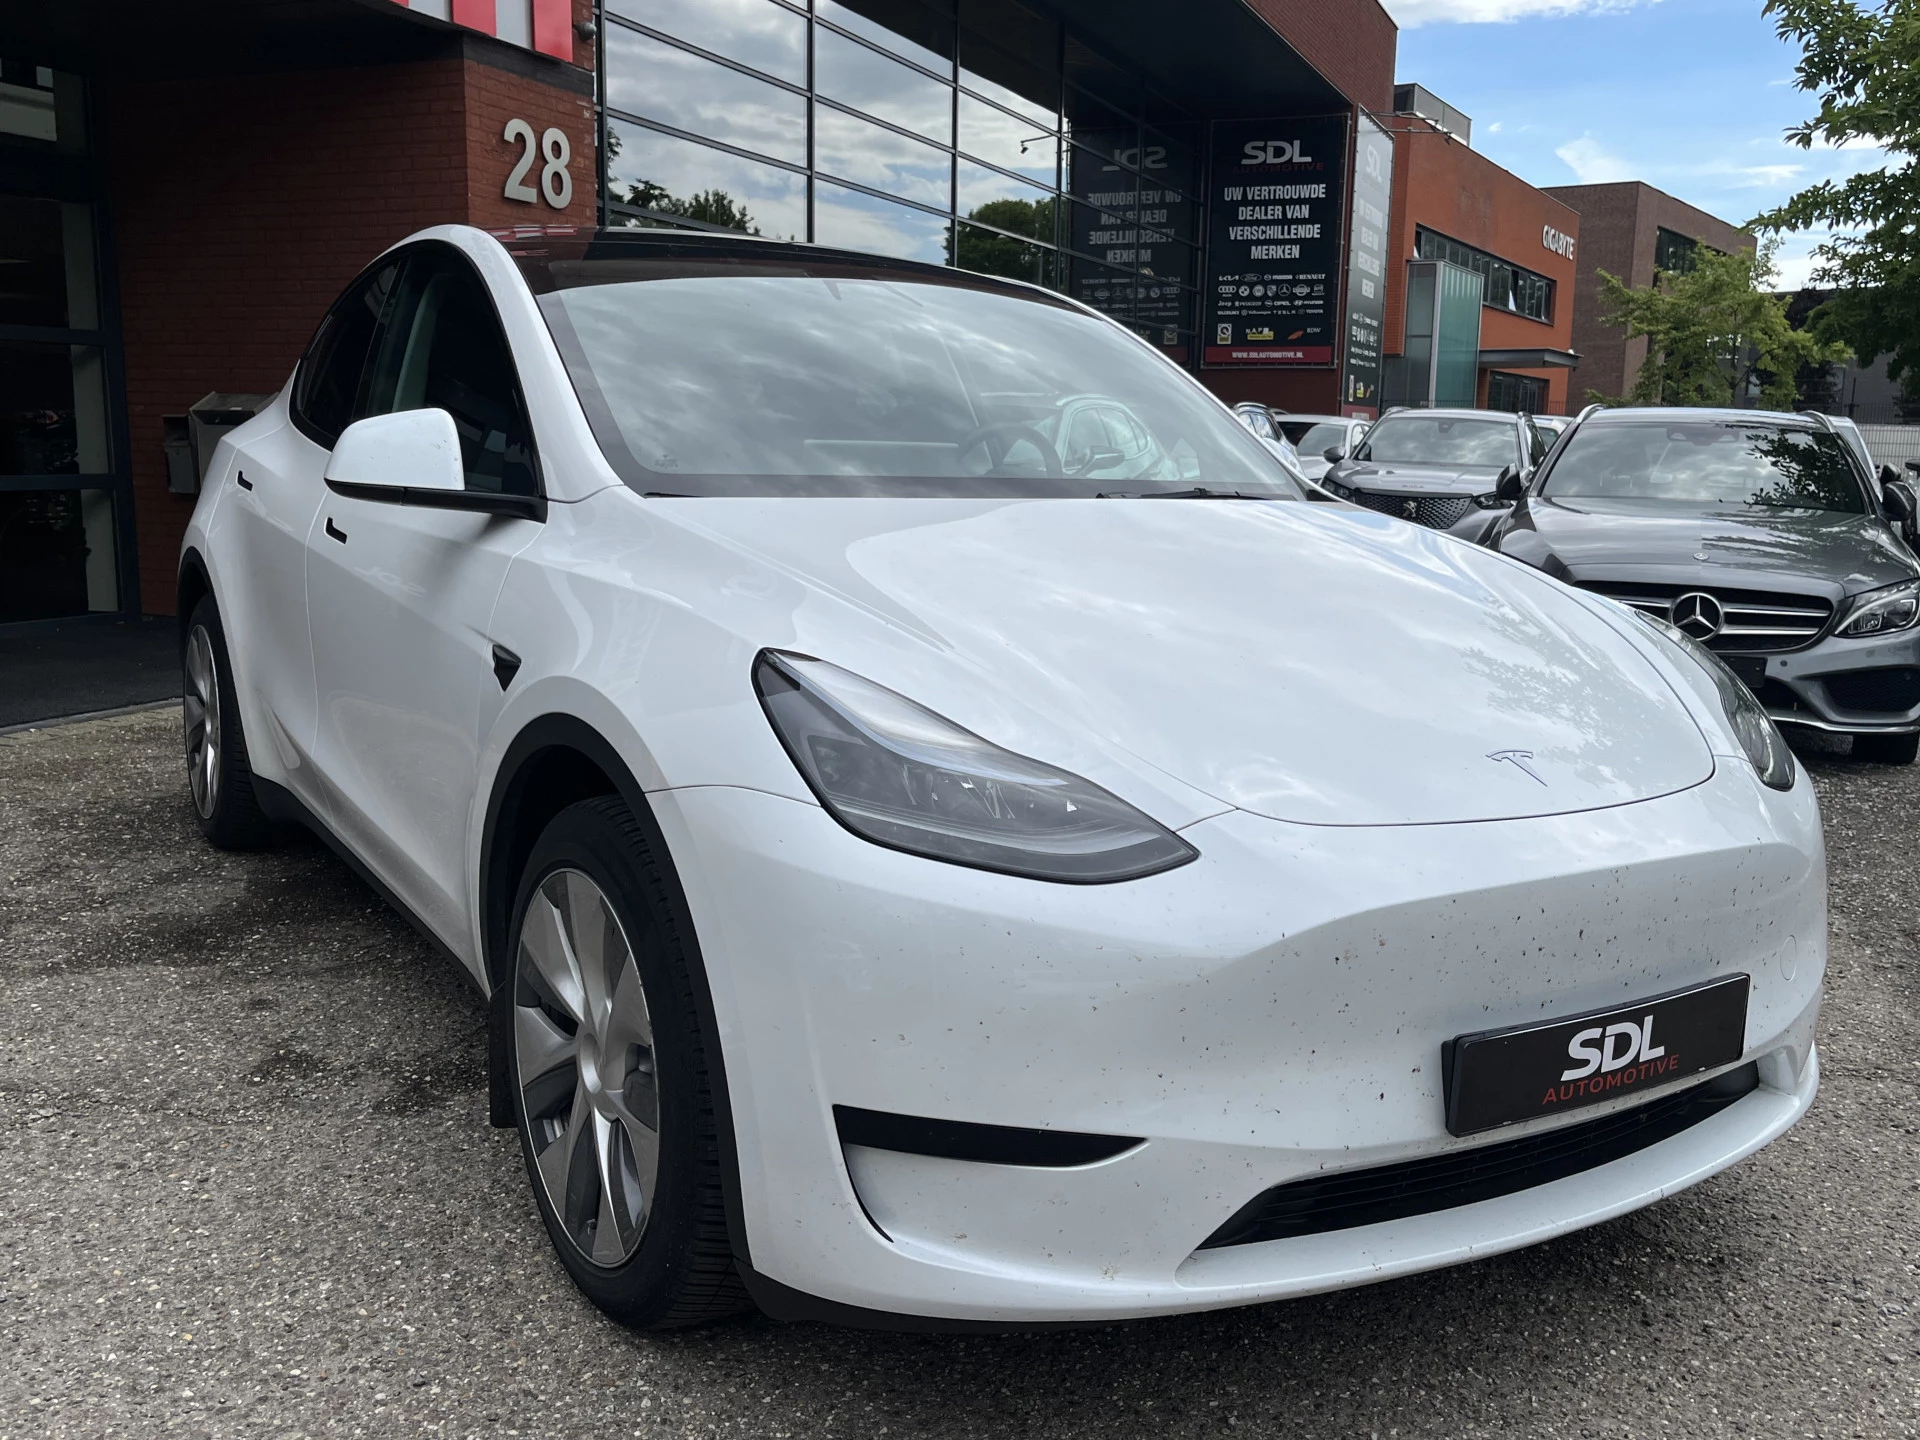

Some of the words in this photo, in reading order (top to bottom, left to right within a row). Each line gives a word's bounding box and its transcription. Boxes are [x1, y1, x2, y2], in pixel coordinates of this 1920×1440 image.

[1241, 140, 1312, 165] SDL
[504, 118, 573, 209] 28
[1232, 162, 1325, 173] AUTOMOTIVE
[1224, 186, 1243, 201] UW
[1246, 184, 1326, 200] VERTROUWDE
[1238, 205, 1283, 220] DEALER
[1286, 204, 1310, 219] VAN
[1229, 224, 1321, 240] VERSCHILLENDE
[1542, 224, 1575, 261] GIGABYTE
[1250, 245, 1300, 260] MERKEN
[1560, 1015, 1665, 1082] SDL
[1542, 1054, 1680, 1106] AUTOMOTIVE
